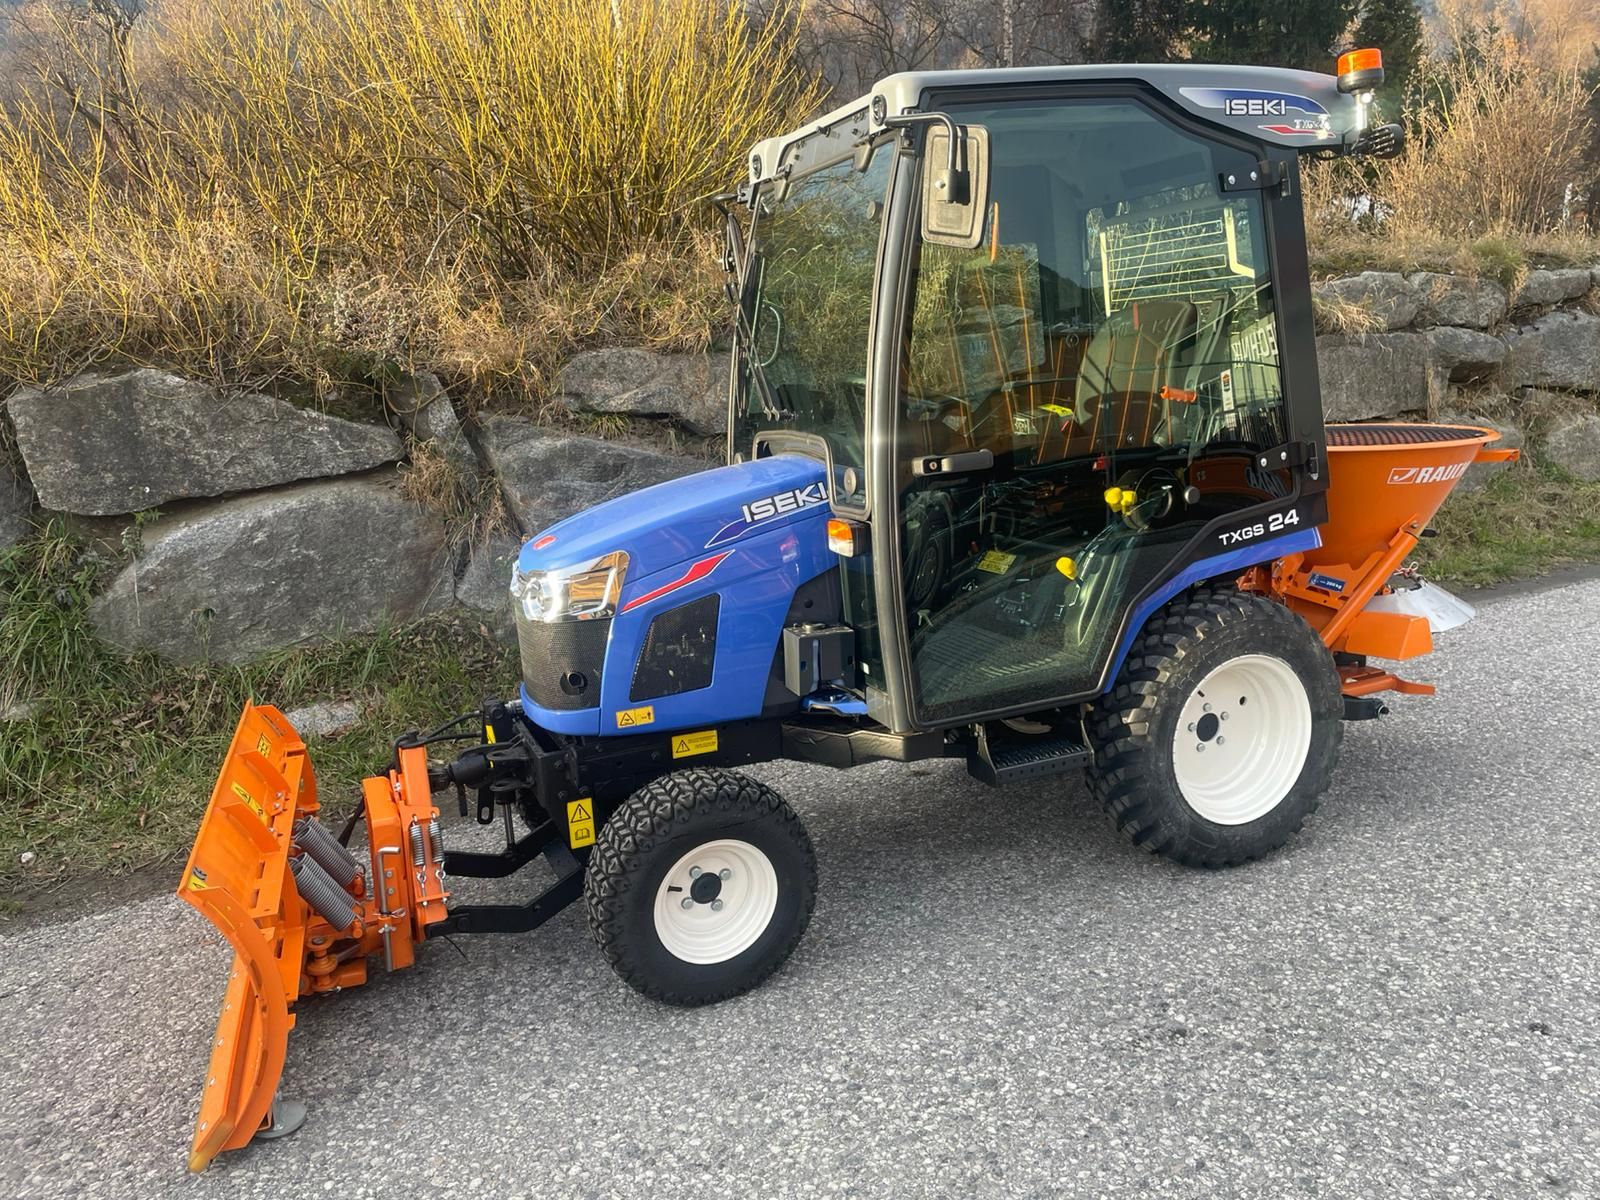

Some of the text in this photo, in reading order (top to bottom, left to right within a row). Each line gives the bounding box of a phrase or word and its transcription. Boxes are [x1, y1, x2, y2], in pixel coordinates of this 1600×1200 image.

[1225, 99, 1286, 116] ISEKI
[742, 482, 828, 523] ISEKI
[1219, 508, 1300, 546] TXGS 24
